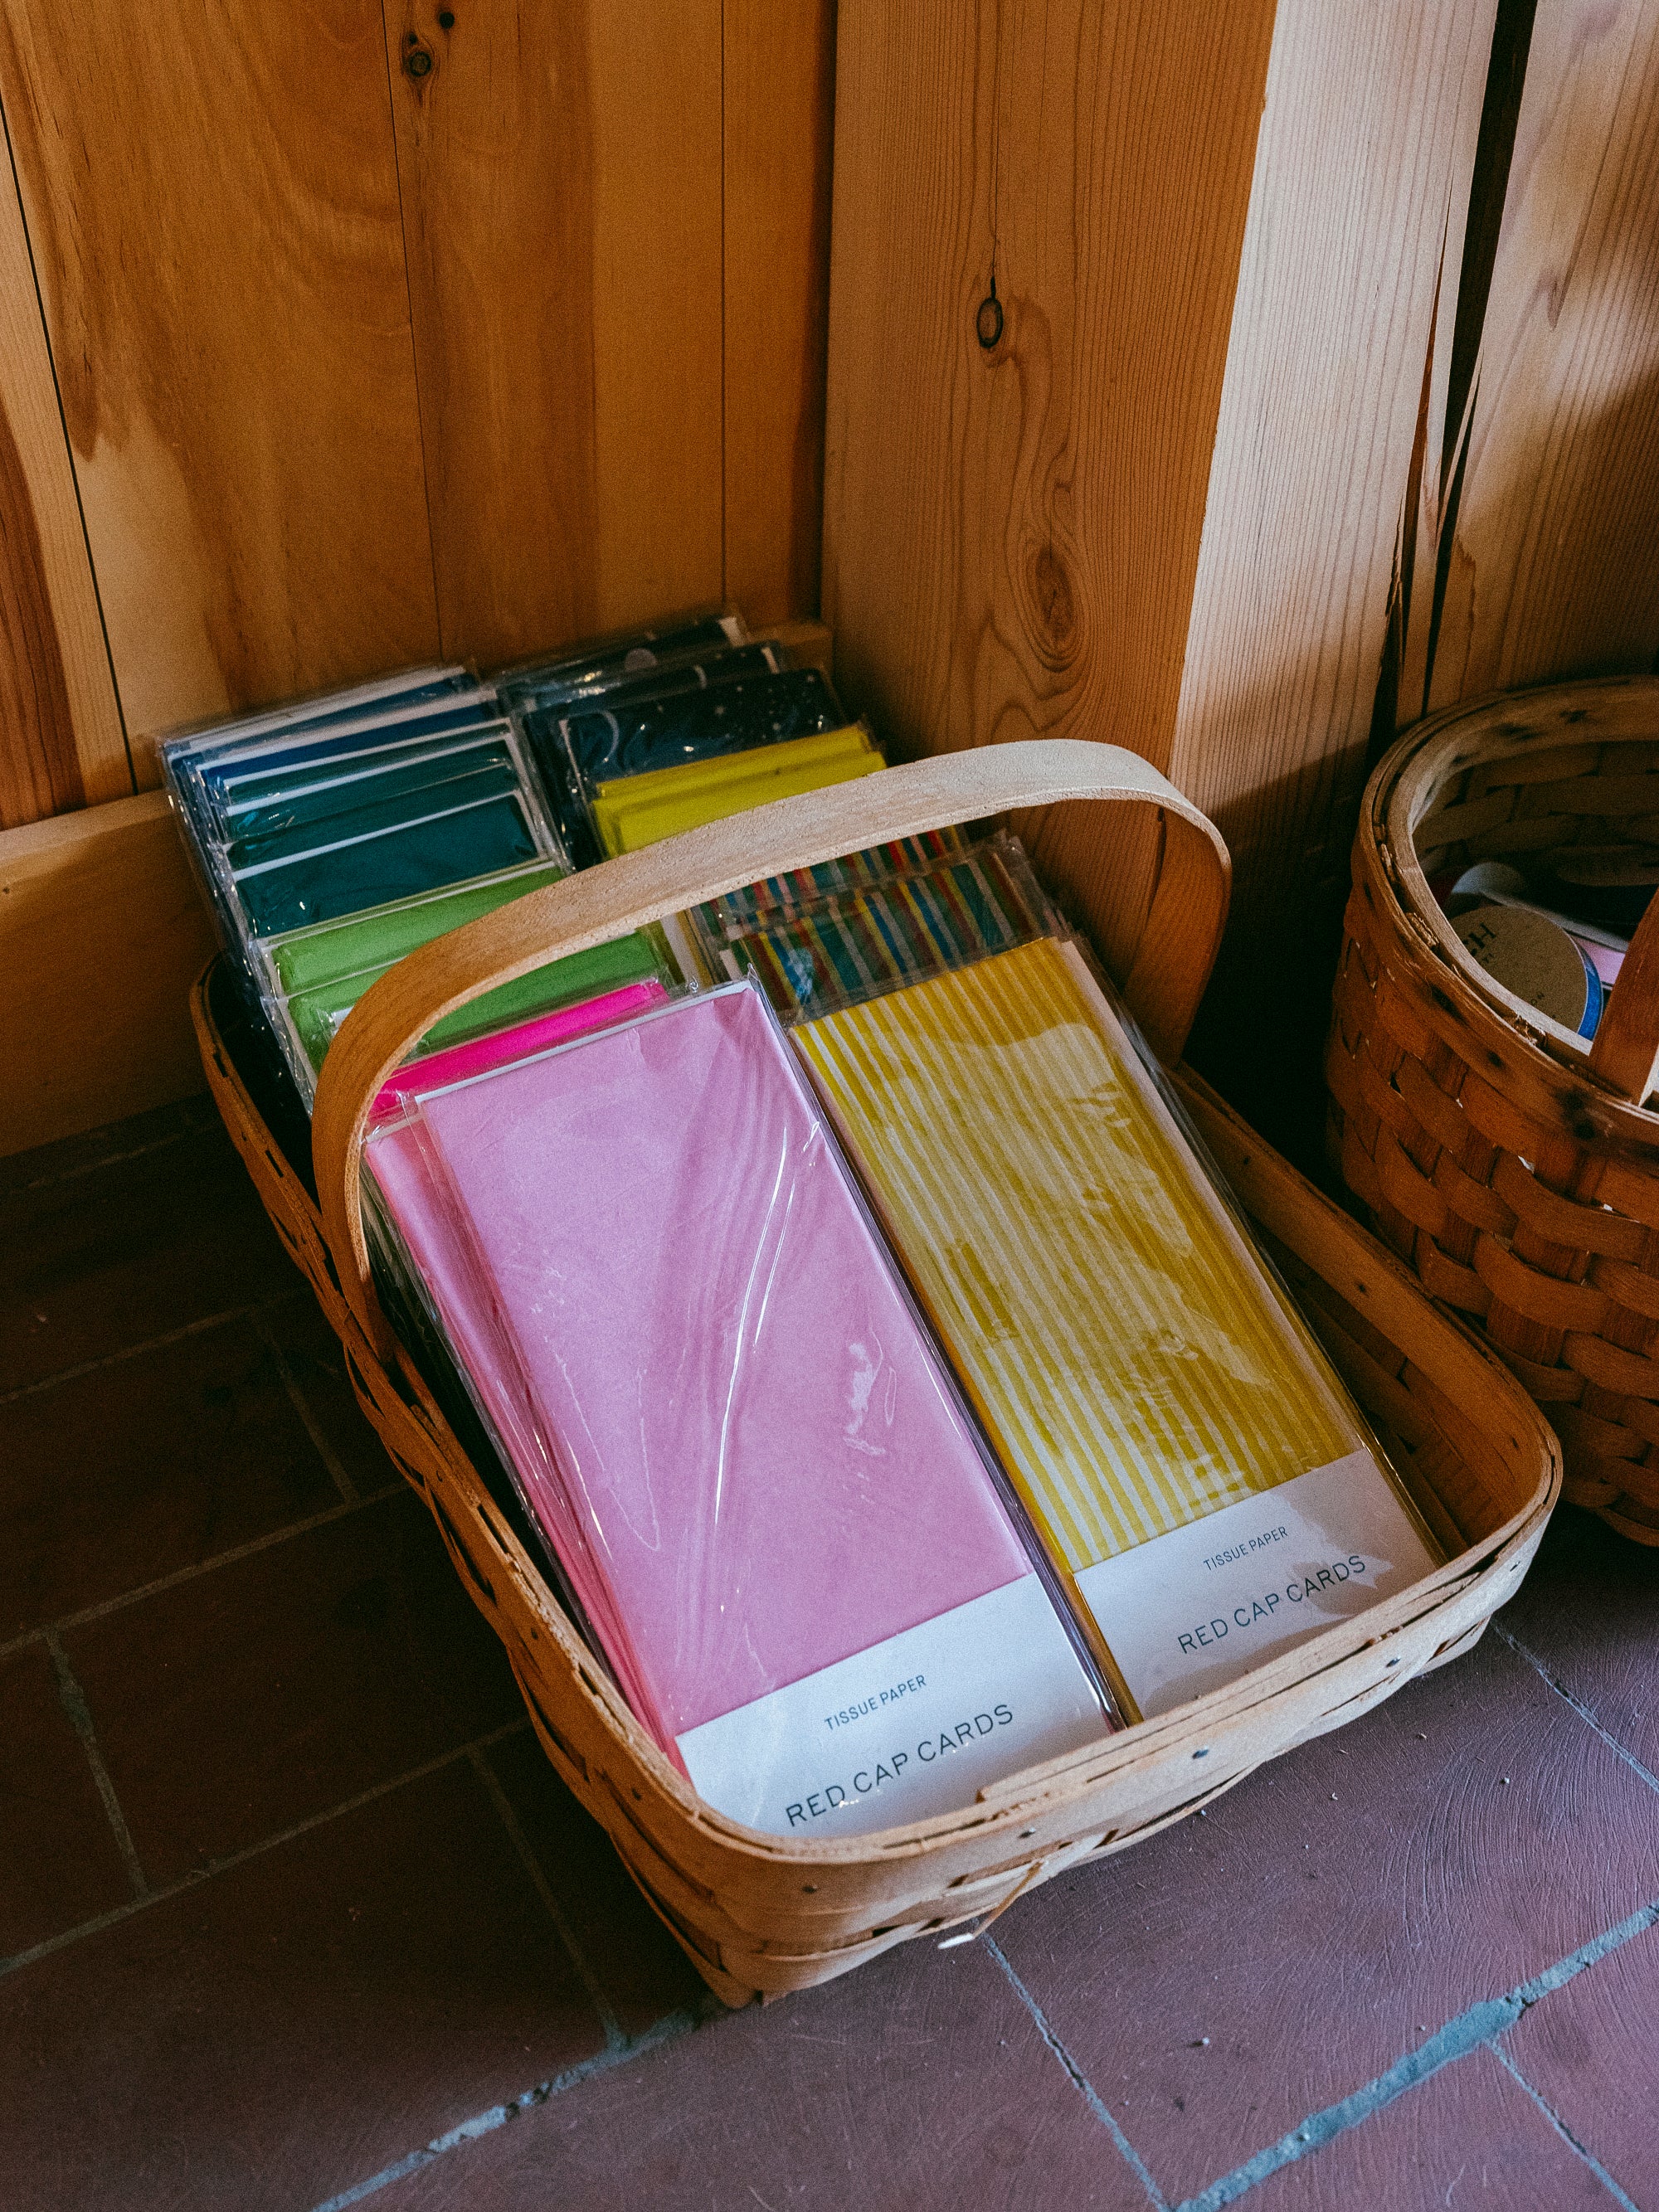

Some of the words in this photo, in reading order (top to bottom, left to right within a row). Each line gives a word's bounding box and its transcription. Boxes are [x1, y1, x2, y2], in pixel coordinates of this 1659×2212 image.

[1203, 1544, 1249, 1571] TISSUE
[1248, 1526, 1288, 1552] PAPER
[1177, 1618, 1228, 1654] RED
[1233, 1592, 1280, 1627] CAP
[1286, 1555, 1365, 1602] CARDS
[824, 1698, 878, 1730] TISSUE
[879, 1675, 927, 1705] PAPER
[786, 1785, 846, 1827] RED
[853, 1752, 908, 1793] CAP
[917, 1704, 1014, 1762] CARDS
